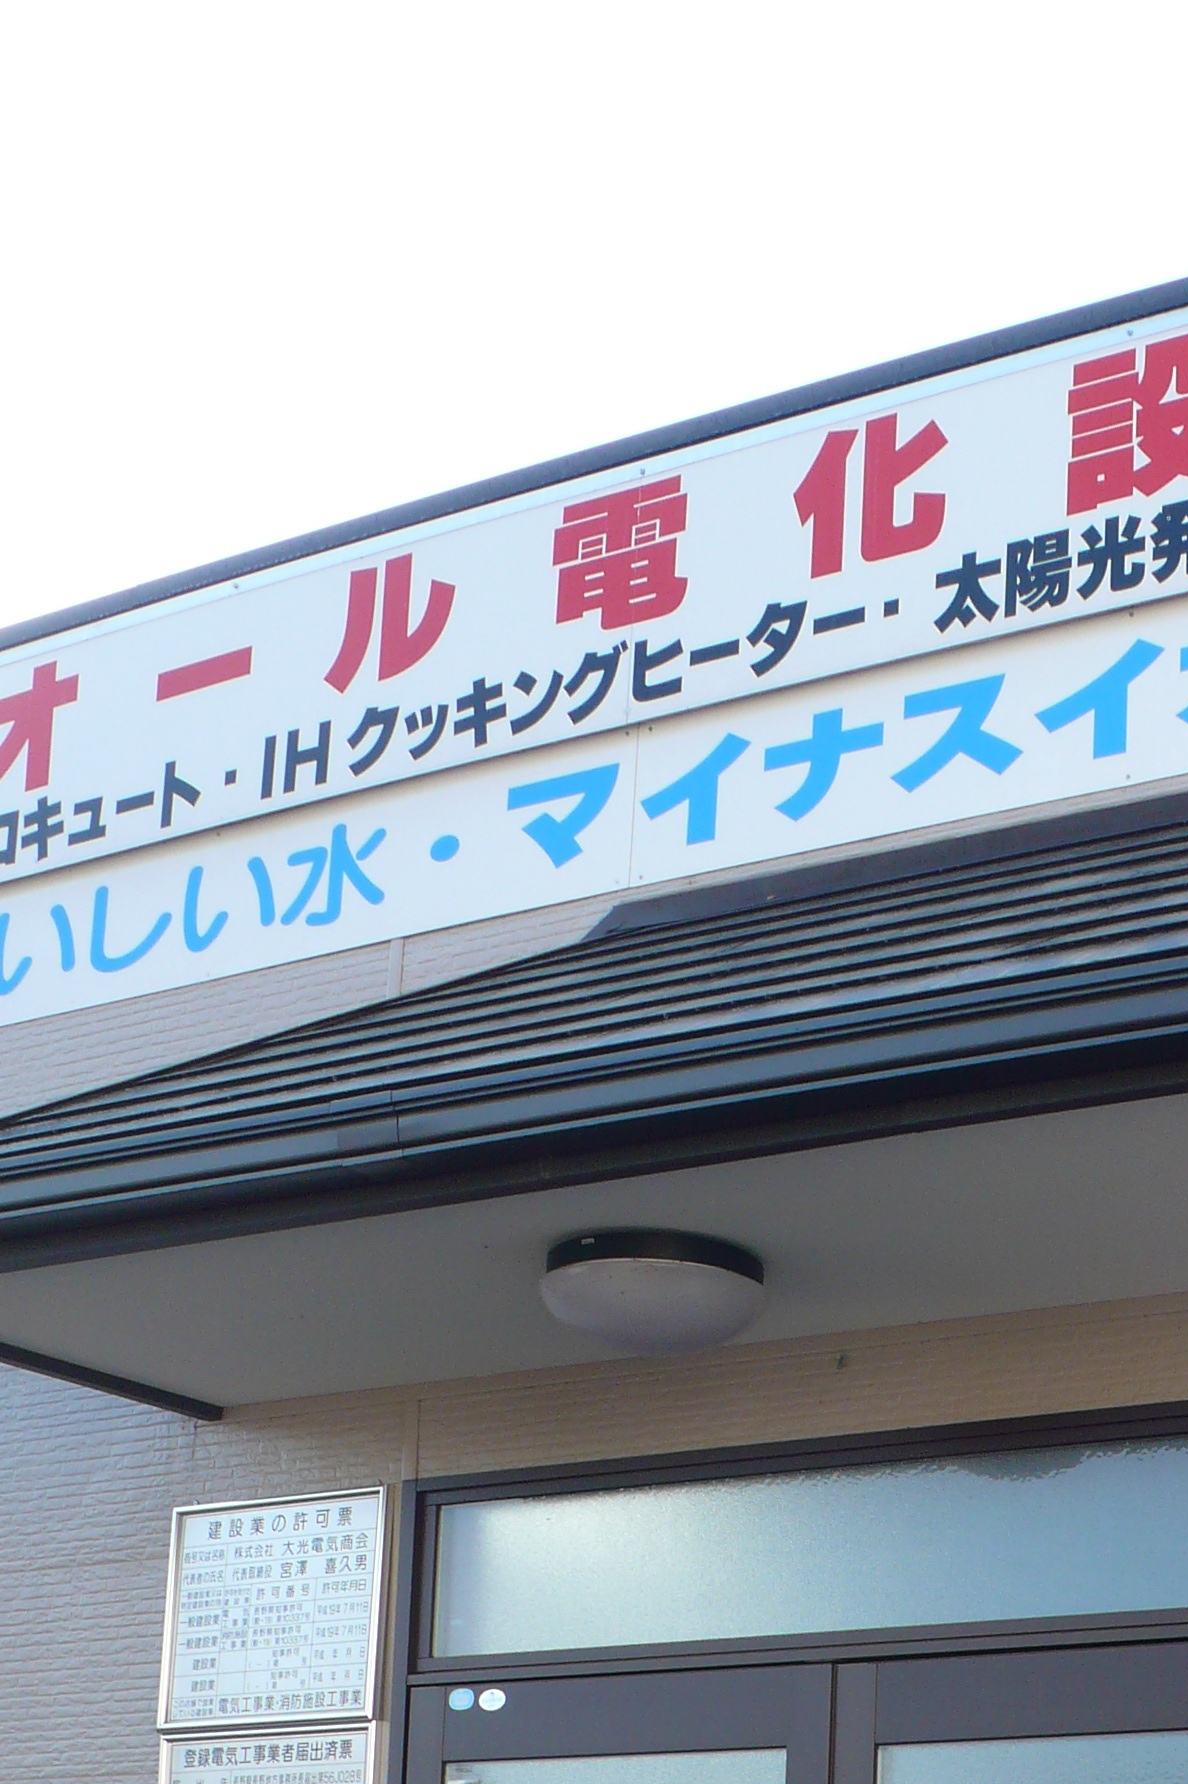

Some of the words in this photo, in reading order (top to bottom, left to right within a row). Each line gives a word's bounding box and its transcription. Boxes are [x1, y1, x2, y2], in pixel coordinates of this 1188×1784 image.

[208, 1506, 353, 1541] 建設業の許可票
[234, 1544, 274, 1559] 株式会社
[282, 1532, 369, 1556] 大光電気商会
[324, 1554, 367, 1574] 喜久男
[321, 1579, 367, 1594] 許可年月日
[184, 1739, 353, 1769] 登録電気工事業者届出済票
